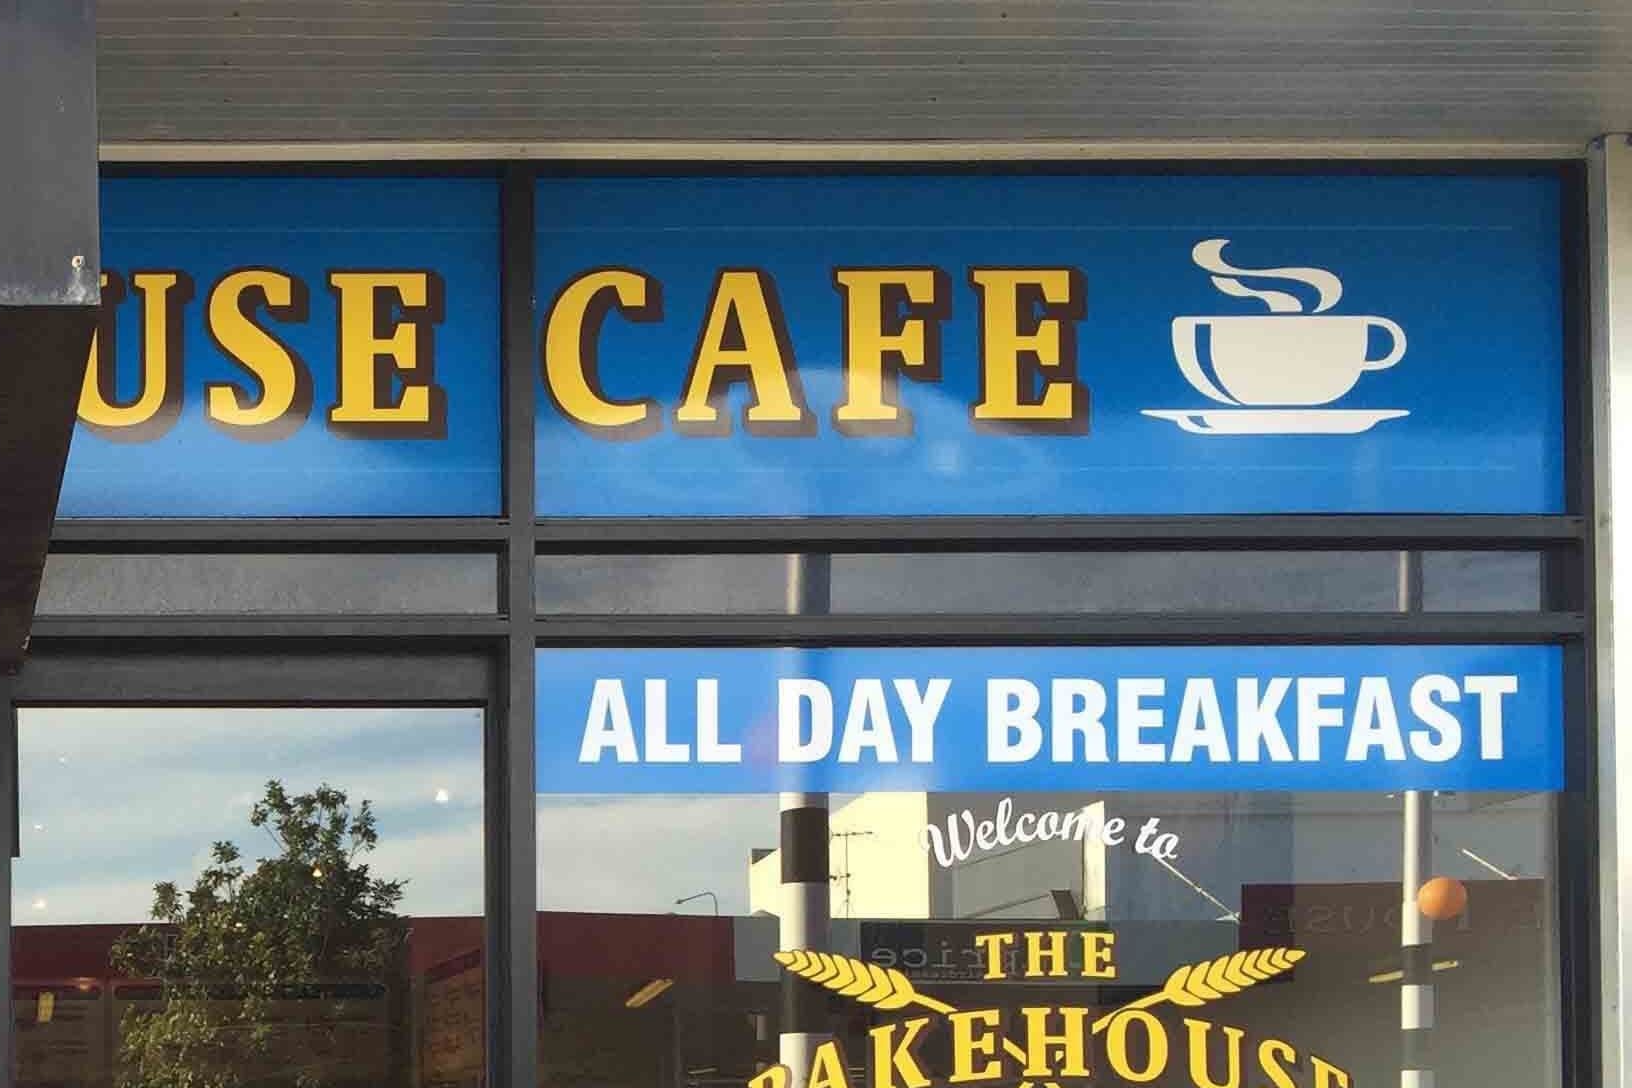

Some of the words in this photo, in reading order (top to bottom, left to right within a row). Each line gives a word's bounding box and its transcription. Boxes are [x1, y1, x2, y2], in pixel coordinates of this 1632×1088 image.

[541, 264, 1090, 440] CAFE
[578, 677, 743, 764] ALL
[778, 677, 952, 764] DAY
[985, 674, 1517, 764] BREAKFAST
[919, 797, 1126, 867] Welcome
[1133, 816, 1179, 860] to
[975, 930, 1118, 979] THE
